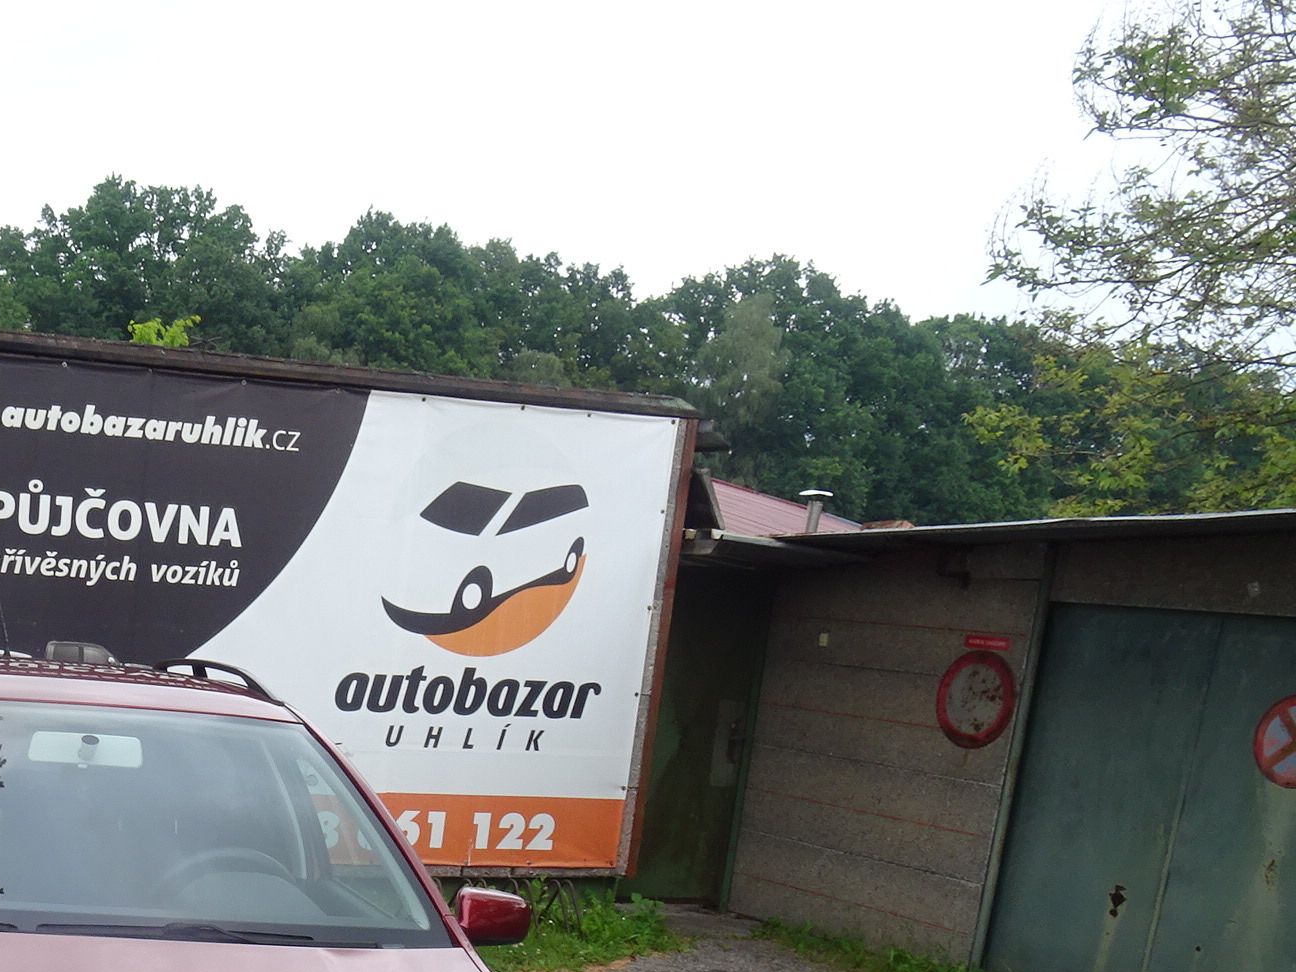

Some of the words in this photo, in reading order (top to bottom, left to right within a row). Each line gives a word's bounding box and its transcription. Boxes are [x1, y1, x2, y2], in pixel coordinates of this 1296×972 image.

[150, 559, 241, 588] vozíků
[334, 665, 602, 719] autobazar
[385, 723, 545, 751] UHLÍK
[473, 812, 555, 850] 122
